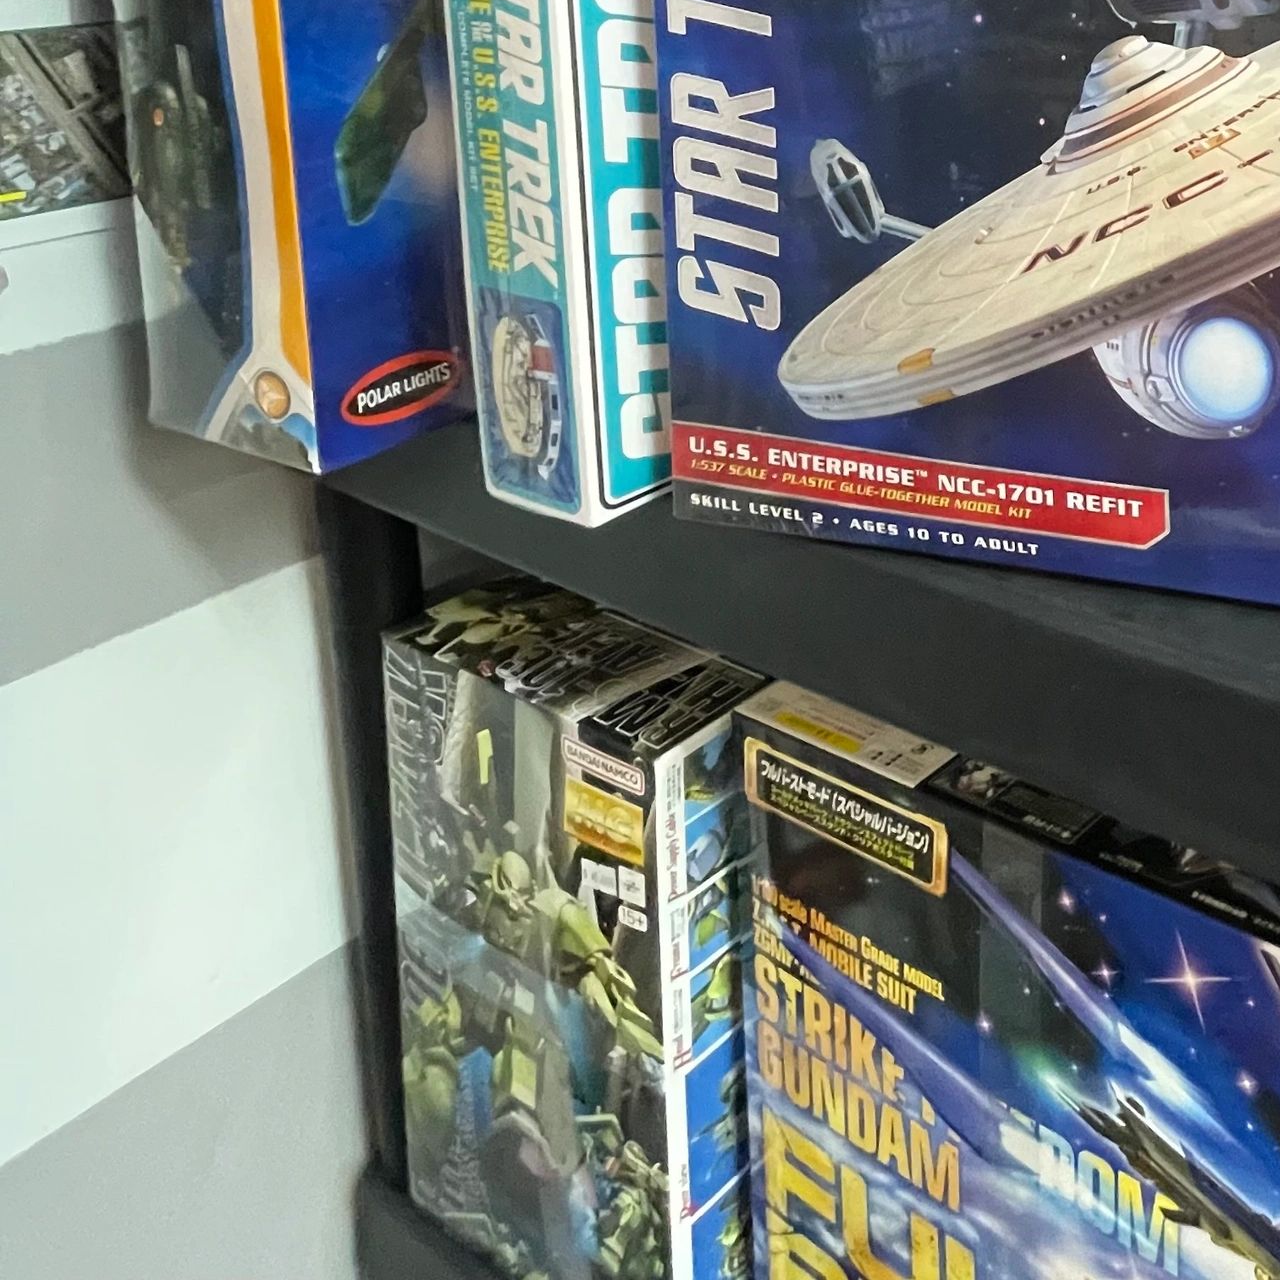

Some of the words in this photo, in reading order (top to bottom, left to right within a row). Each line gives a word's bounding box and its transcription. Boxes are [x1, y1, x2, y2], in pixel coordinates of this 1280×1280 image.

[471, 46, 498, 119] U.S.S.
[477, 127, 512, 274] ENTERPRISE
[502, 118, 558, 290] TREK
[669, 71, 782, 331] STAR
[356, 381, 403, 414] POLAR
[402, 361, 452, 395] LIGHTS
[688, 436, 759, 463] U.S.S.
[937, 474, 1055, 507] NCC-1701
[1066, 491, 1144, 518] REFIT
[690, 459, 726, 473] 1:537
[728, 464, 768, 481] SCALE
[781, 472, 836, 491] PLASTIC
[839, 482, 950, 508] GLUE-TOGETHER
[954, 499, 1003, 516] MODEL
[1007, 506, 1032, 520] KIT
[690, 492, 742, 513] SKILL
[749, 502, 804, 522] LEVEL
[811, 511, 824, 525] 2
[849, 518, 899, 536] AGES
[907, 527, 930, 541] 10
[938, 531, 965, 545] TO
[973, 535, 1039, 556] ADULT
[566, 743, 602, 771] BANDAI
[600, 757, 639, 786] NAMCO
[620, 906, 645, 928] 15+
[808, 931, 874, 990] MOBILE
[875, 974, 918, 1015] SUIT
[757, 1019, 961, 1214] GUNDAM
